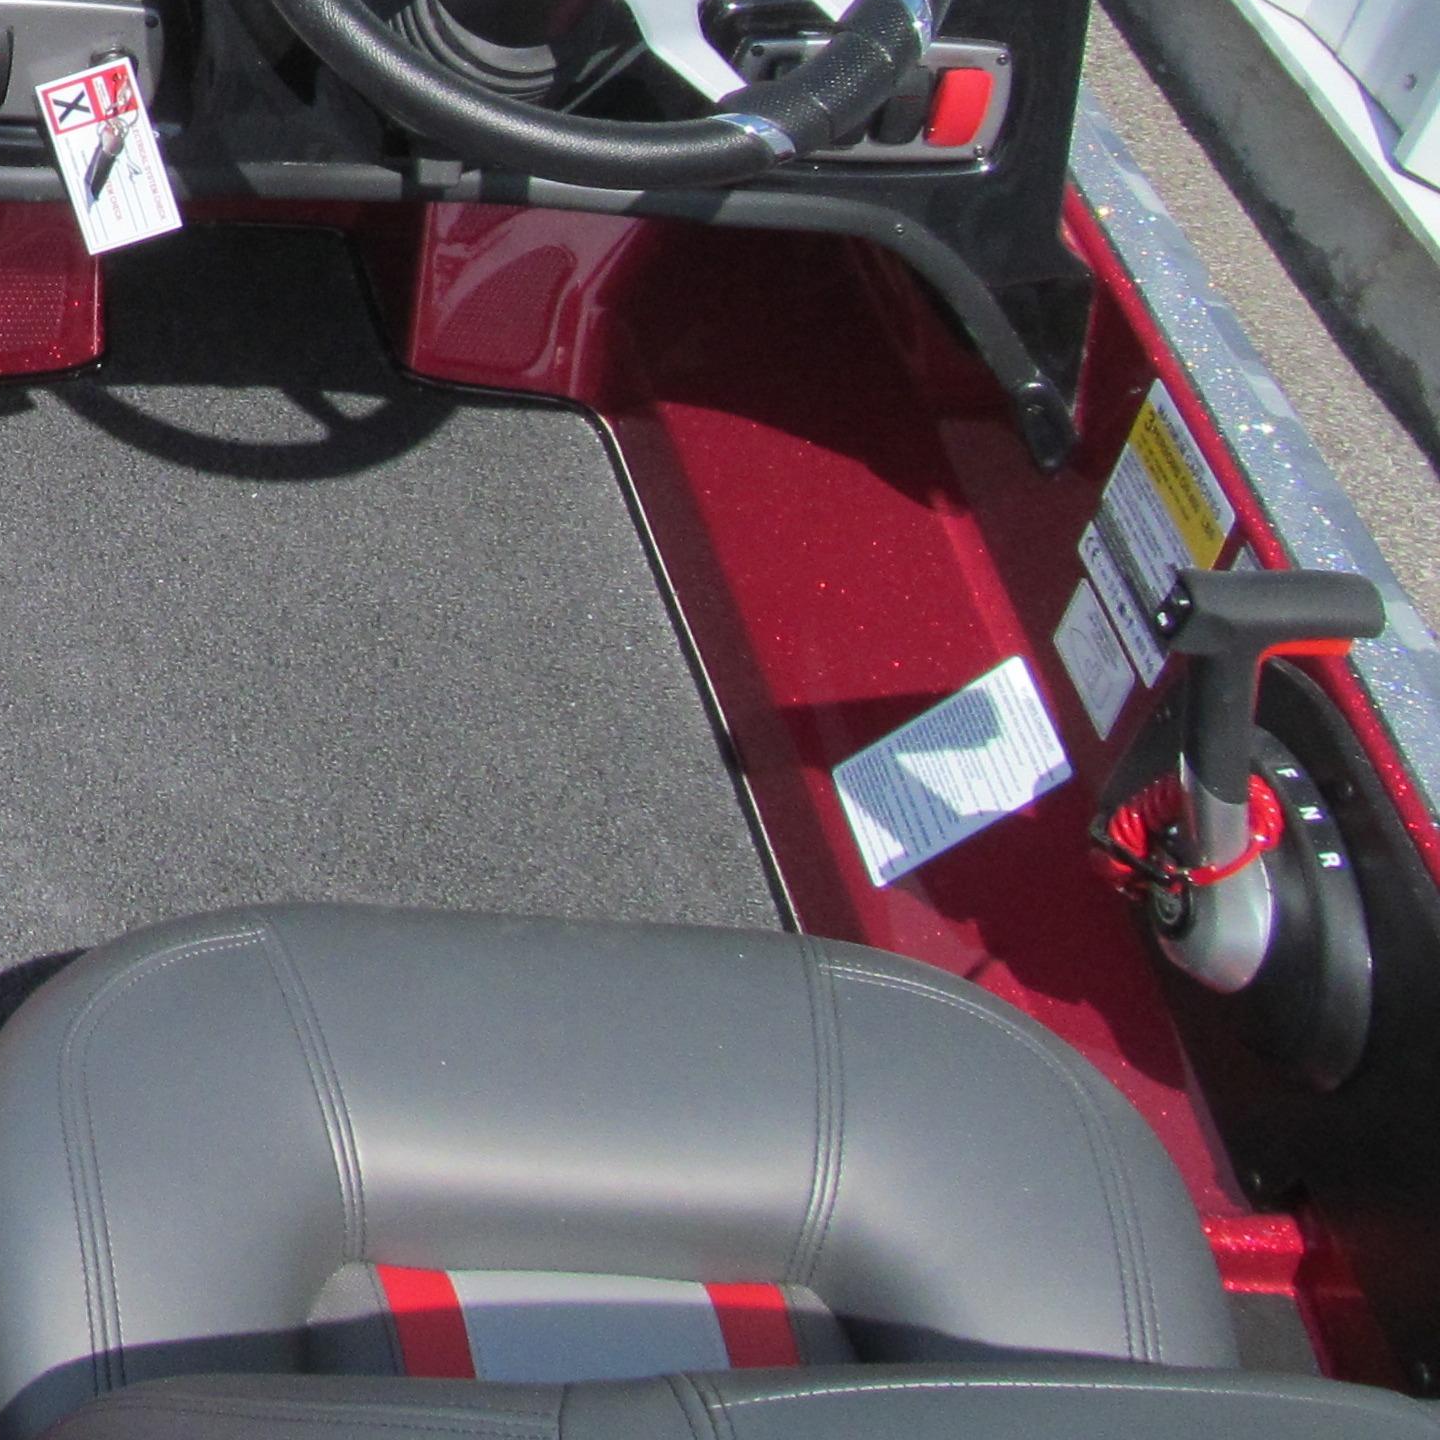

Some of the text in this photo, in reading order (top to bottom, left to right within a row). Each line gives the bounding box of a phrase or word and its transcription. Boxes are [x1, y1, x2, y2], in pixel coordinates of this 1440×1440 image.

[144, 165, 159, 195] SYSTEM
[153, 194, 167, 221] CHECK
[109, 194, 124, 221] CHECK
[1275, 767, 1300, 778] F
[1298, 806, 1324, 821] N
[1317, 851, 1342, 869] R
